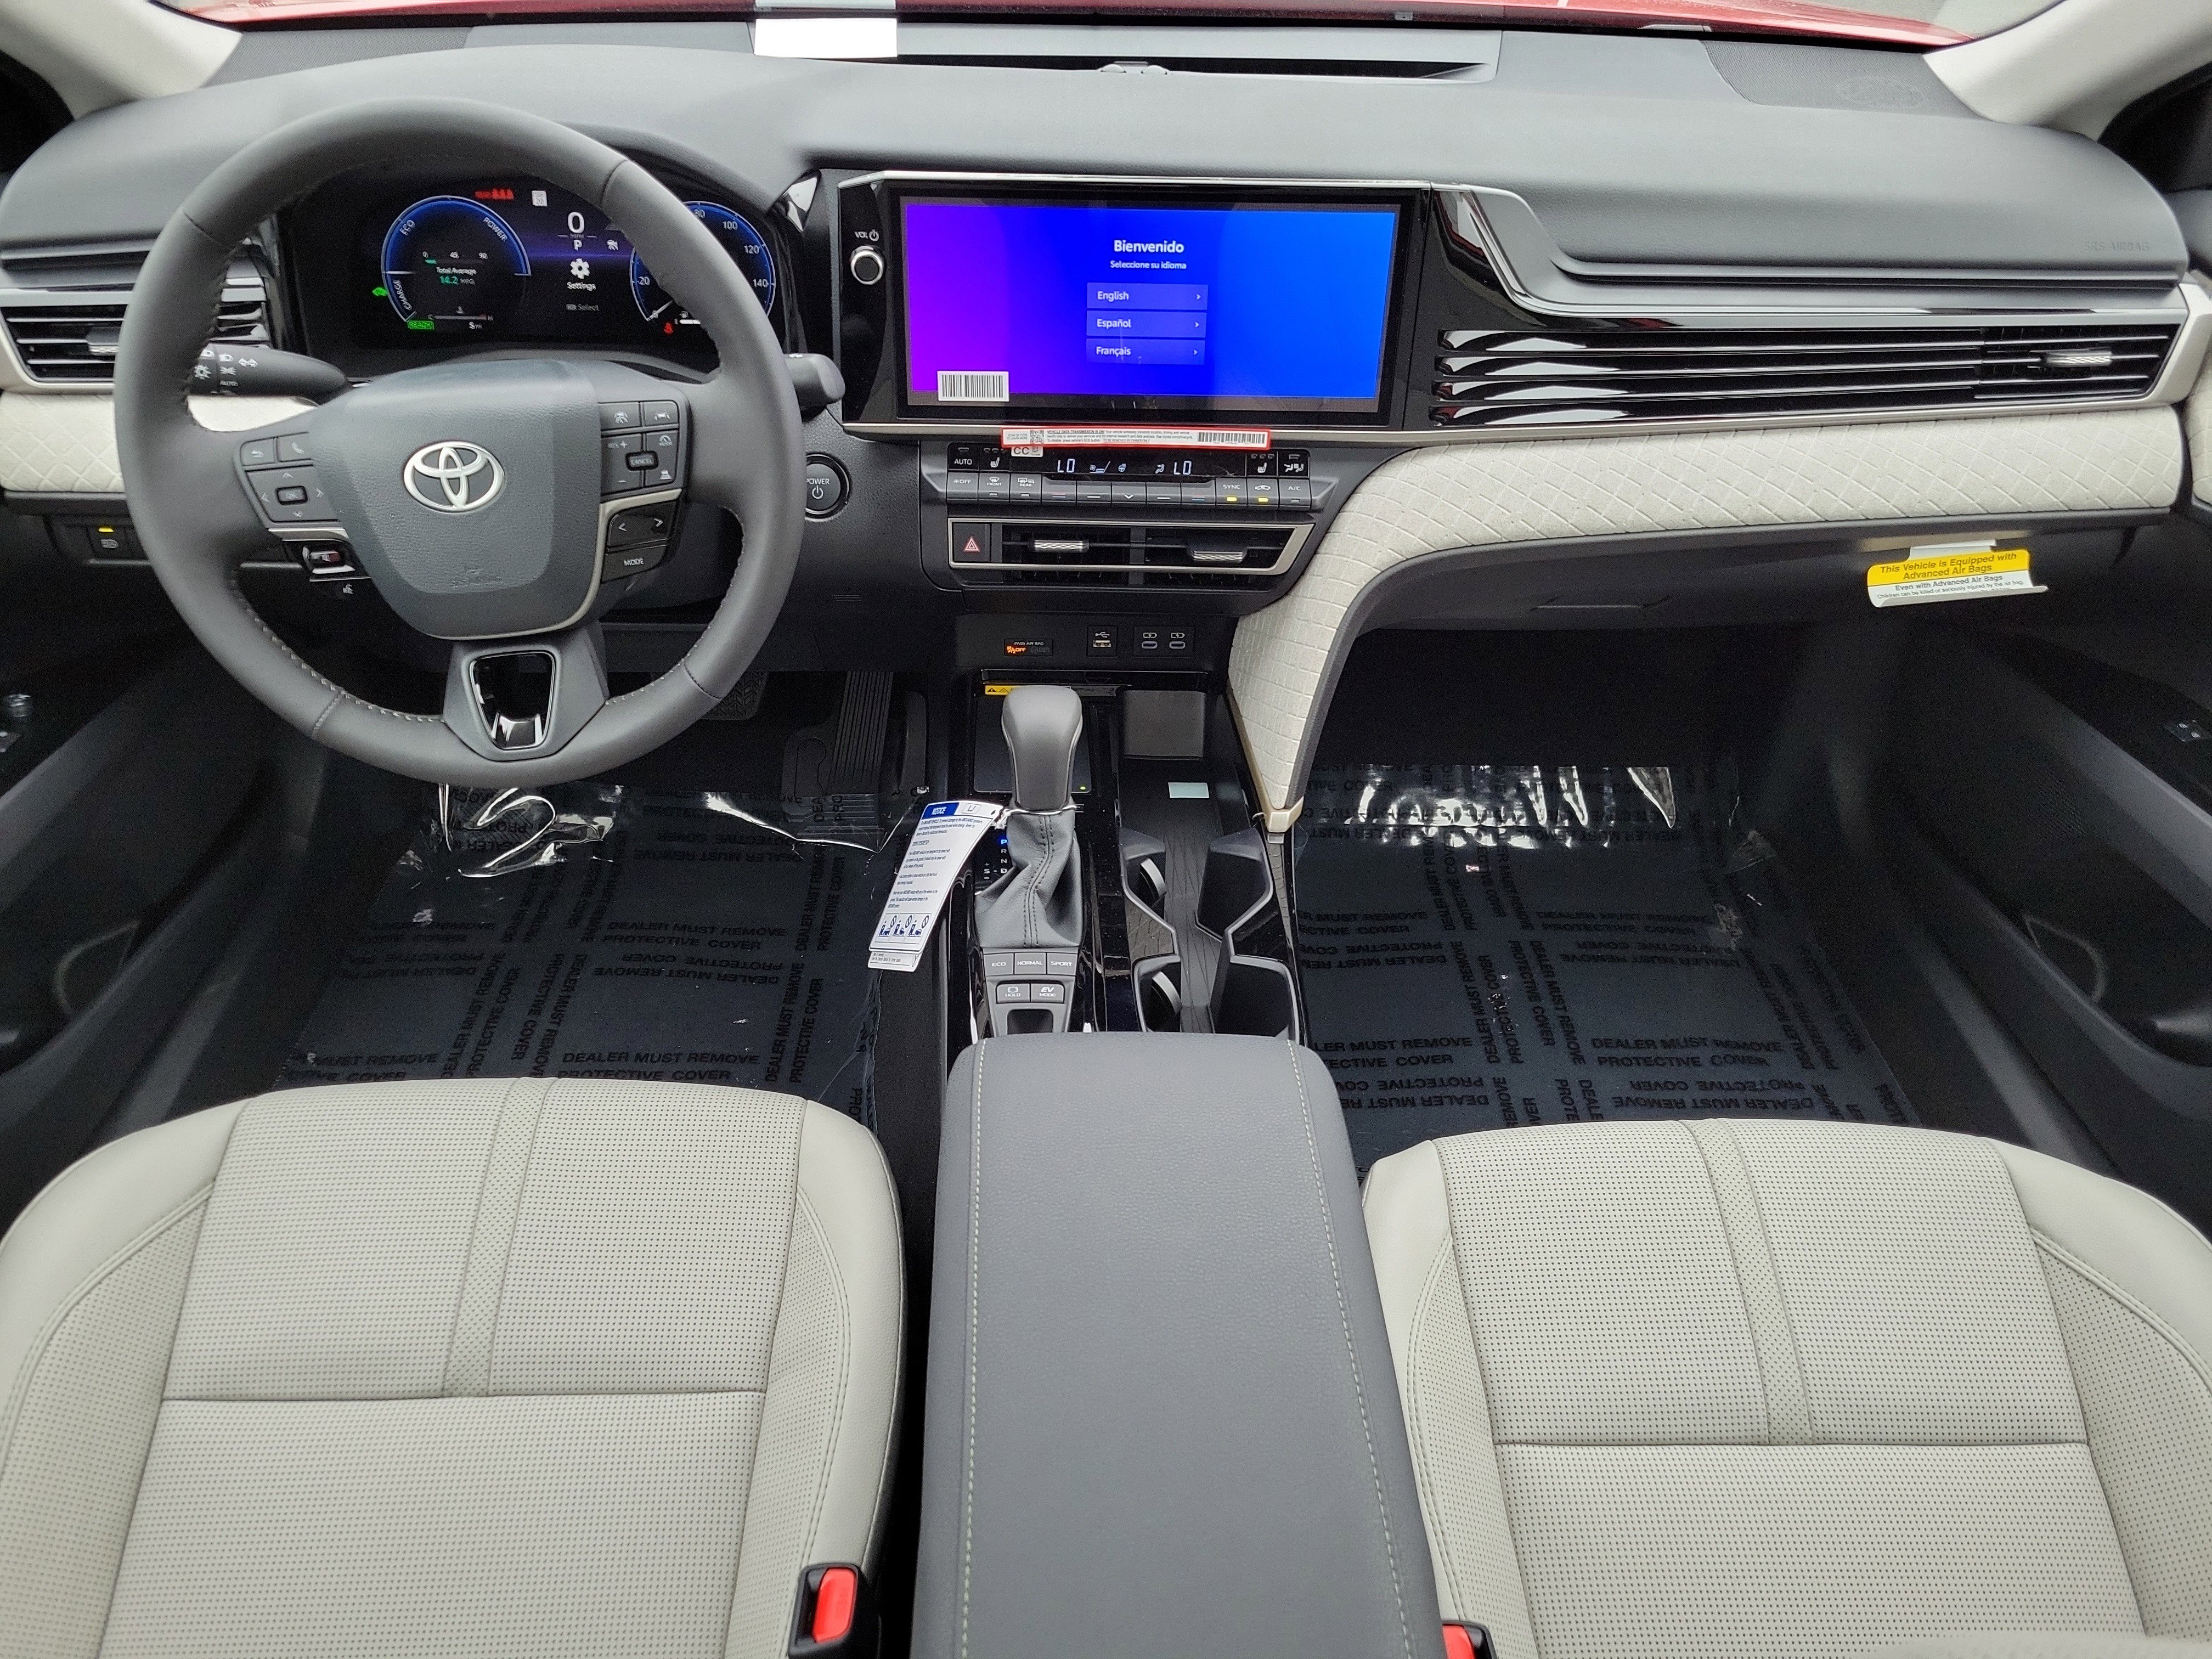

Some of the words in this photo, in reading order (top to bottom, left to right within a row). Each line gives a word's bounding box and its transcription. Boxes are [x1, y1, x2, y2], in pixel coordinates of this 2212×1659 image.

[399, 219, 415, 236] ECO
[483, 217, 507, 241] POWER
[567, 212, 585, 234] 0
[723, 221, 738, 230] 100
[574, 240, 582, 251] P
[743, 245, 759, 255] 120
[1114, 239, 1184, 253] Bienvenido
[2084, 241, 2104, 251] SRS
[2109, 241, 2151, 251] AIRBAG
[1110, 260, 1149, 269] Seleccione
[1160, 261, 1187, 269] idioma
[439, 276, 459, 285] 14.2
[567, 282, 596, 291] Settings
[639, 276, 650, 285] 20
[753, 278, 768, 287] 140
[1097, 291, 1129, 302] English
[1096, 319, 1131, 329] Español
[1096, 346, 1131, 357] Français
[1013, 447, 1029, 455] CC
[1057, 458, 1075, 473] LO
[1173, 460, 1192, 476] LO
[623, 557, 645, 566] MODE
[1903, 561, 1936, 571] Vehicle
[1950, 555, 1994, 566] Equipped
[1903, 568, 1949, 580] Advanced
[1952, 566, 1965, 574] Air
[1968, 565, 1992, 573] Bags
[1933, 578, 1969, 587] Advanced
[1364, 911, 1427, 921] REMOVE
[607, 922, 669, 932] DEALER
[673, 923, 720, 933] MUST
[721, 927, 787, 936] REMOVE
[602, 935, 700, 946] PROTECTIVE
[708, 939, 761, 950] COVER
[1347, 941, 1443, 953] PROTECTIVE
[1576, 941, 1629, 950] COVER
[622, 953, 676, 963] COVER
[685, 956, 783, 970] PROTECTIVE
[1338, 958, 1381, 969] MUST
[1385, 955, 1447, 966] DEALER
[1449, 940, 1476, 982] REMOVE
[1559, 953, 1626, 963] REMOVE
[1631, 955, 1674, 964] MUST
[561, 954, 588, 992] DEALER
[592, 967, 662, 976] REMOVE
[665, 969, 712, 980] MUST
[1477, 955, 1501, 994] COVER
[716, 972, 780, 984] DEALER
[783, 962, 805, 1005] REMOVE
[528, 953, 565, 1016] PROTECTIVE
[1465, 984, 1486, 1015] MUST
[1508, 940, 1542, 1004] PROTECTIVE
[1532, 1006, 1556, 1047] COVER
[1530, 940, 1555, 978] DEALER
[1545, 980, 1568, 1013] MUST
[1558, 1014, 1585, 1065] REMOVE
[440, 1034, 467, 1079] DEALER
[461, 998, 484, 1030] MUST
[476, 952, 506, 996] REMOVE
[549, 995, 571, 1026] MUST
[465, 1007, 505, 1078] PROTECTIVE
[496, 967, 520, 1004] COVER
[776, 1007, 794, 1036] MUST
[789, 1013, 815, 1084] PROTECTIVE
[804, 978, 823, 1013] COVER
[511, 1019, 537, 1060] COVER
[1350, 1040, 1397, 1052] MUST
[1401, 1037, 1473, 1049] REMOVE
[1475, 1017, 1500, 1065] DEALER
[1592, 1037, 1657, 1049] DEALER
[1661, 1037, 1708, 1049] MUST
[1712, 1039, 1784, 1052] REMOVE
[365, 1053, 439, 1065] REMOVE
[562, 1052, 629, 1063] DEALER
[634, 1053, 684, 1064] MUST
[687, 1053, 760, 1065] REMOVE
[765, 1036, 788, 1082] DEALER
[1395, 1054, 1454, 1066] COVER
[1597, 1056, 1702, 1067] PROTECTIVE
[1710, 1054, 1770, 1066] COVER
[557, 1069, 664, 1081] PROTECTIVE
[672, 1070, 731, 1080] COVER
[1378, 1077, 1485, 1091] PROTECTIVE
[1630, 1080, 1689, 1091] COVER
[1696, 1079, 1805, 1091] PROTECTIVE
[1367, 1096, 1417, 1109] MUST
[1421, 1095, 1489, 1107] DEALER
[1612, 1096, 1686, 1109] REMOVE
[1692, 1098, 1740, 1109] MUST
[1745, 1098, 1814, 1110] DEALER
